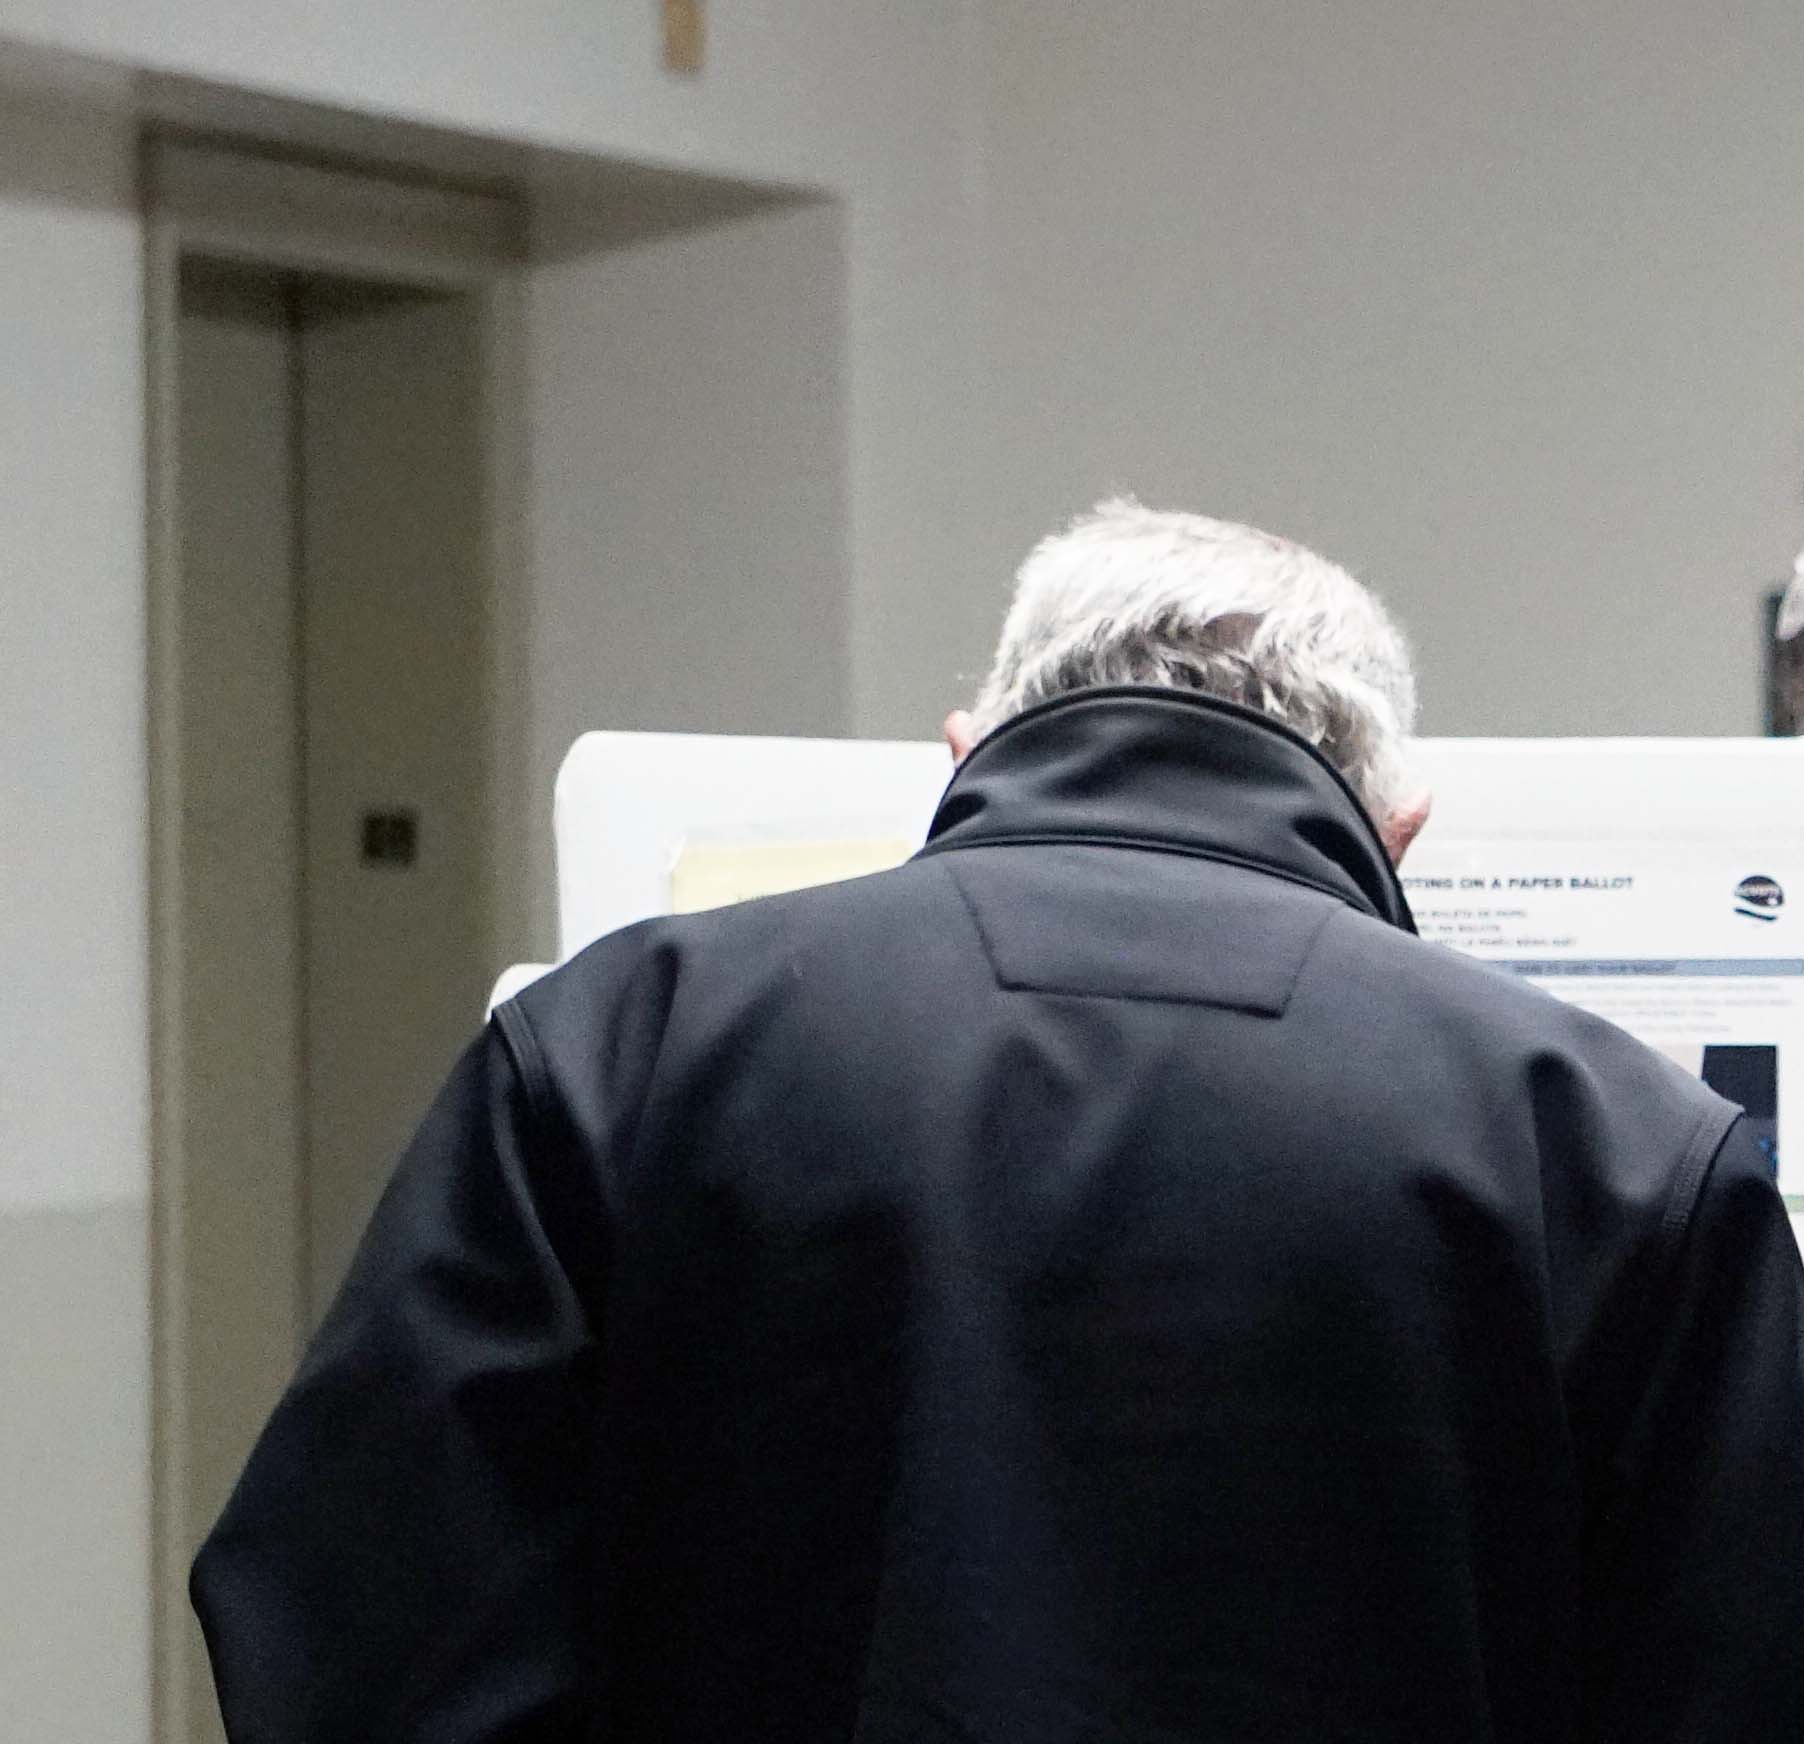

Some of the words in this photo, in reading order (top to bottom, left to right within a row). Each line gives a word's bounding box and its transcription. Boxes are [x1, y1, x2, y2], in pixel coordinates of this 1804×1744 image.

[1459, 877, 1485, 890] ON
[1508, 877, 1563, 890] PAPER
[1570, 877, 1634, 890] BALLOT
